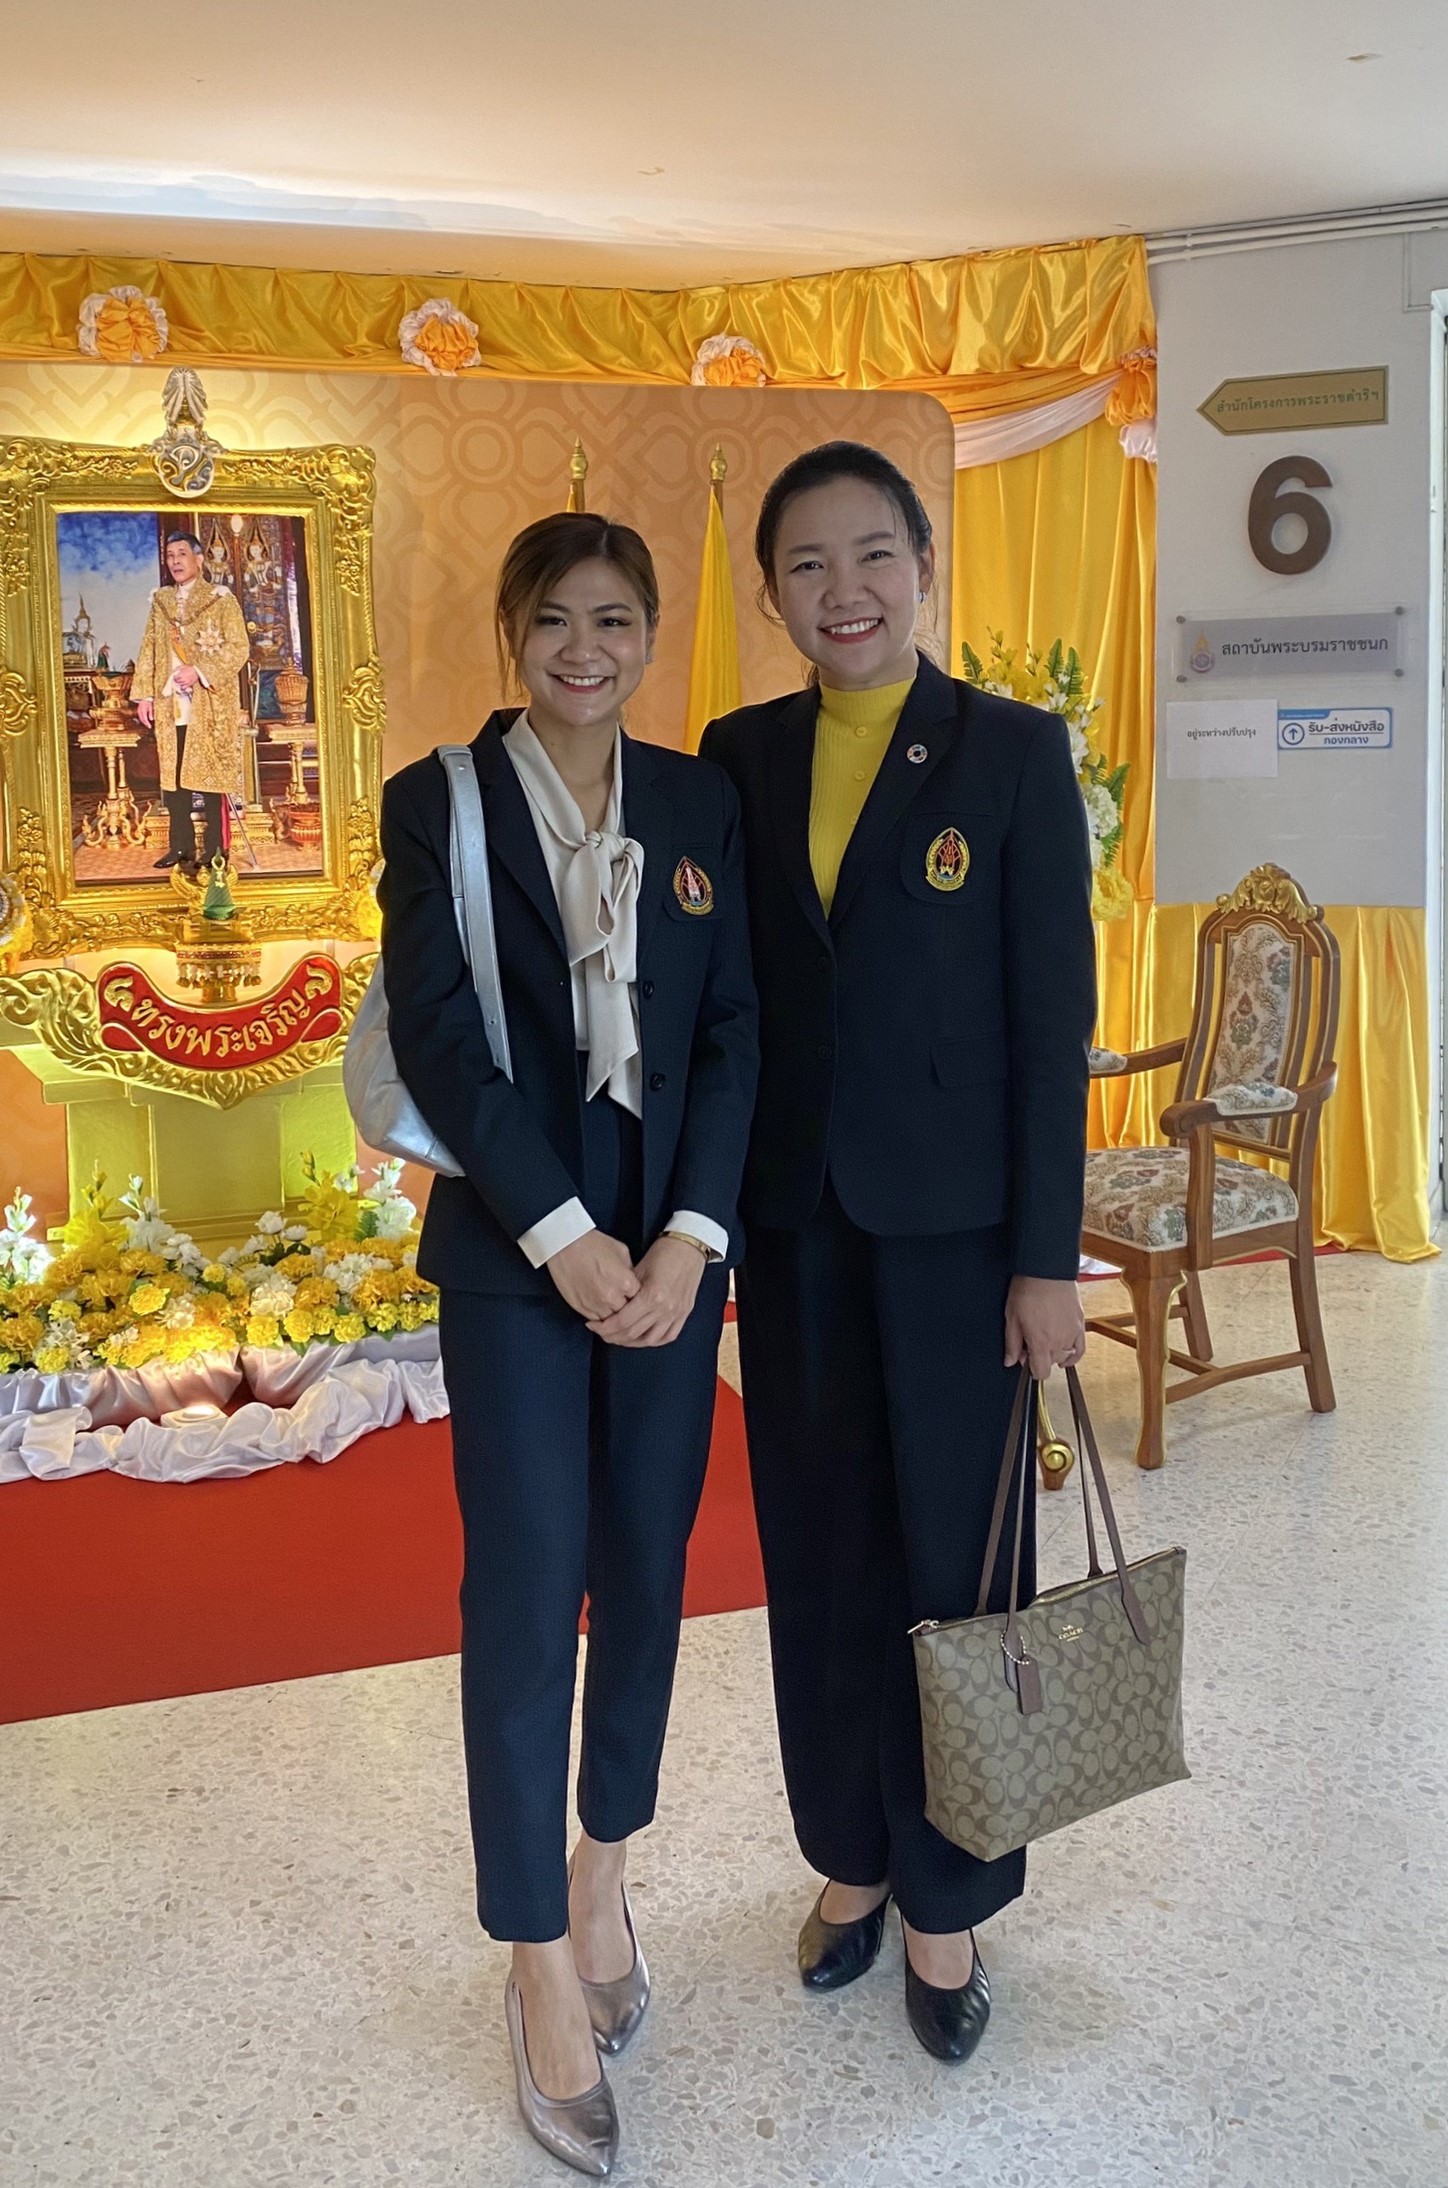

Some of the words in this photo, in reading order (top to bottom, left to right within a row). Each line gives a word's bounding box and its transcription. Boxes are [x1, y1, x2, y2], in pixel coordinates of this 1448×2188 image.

[1247, 455, 1333, 576] 6
[1221, 637, 1389, 656] สถาบันพระบรมราชชนก
[1186, 726, 1257, 741] อยู่ระหว่างปรับปรุง
[1308, 717, 1385, 733] รับ-ส่งหนังสือ
[1323, 735, 1370, 745] กองกลาง
[131, 989, 311, 1057] ทรงพระเจริญ
